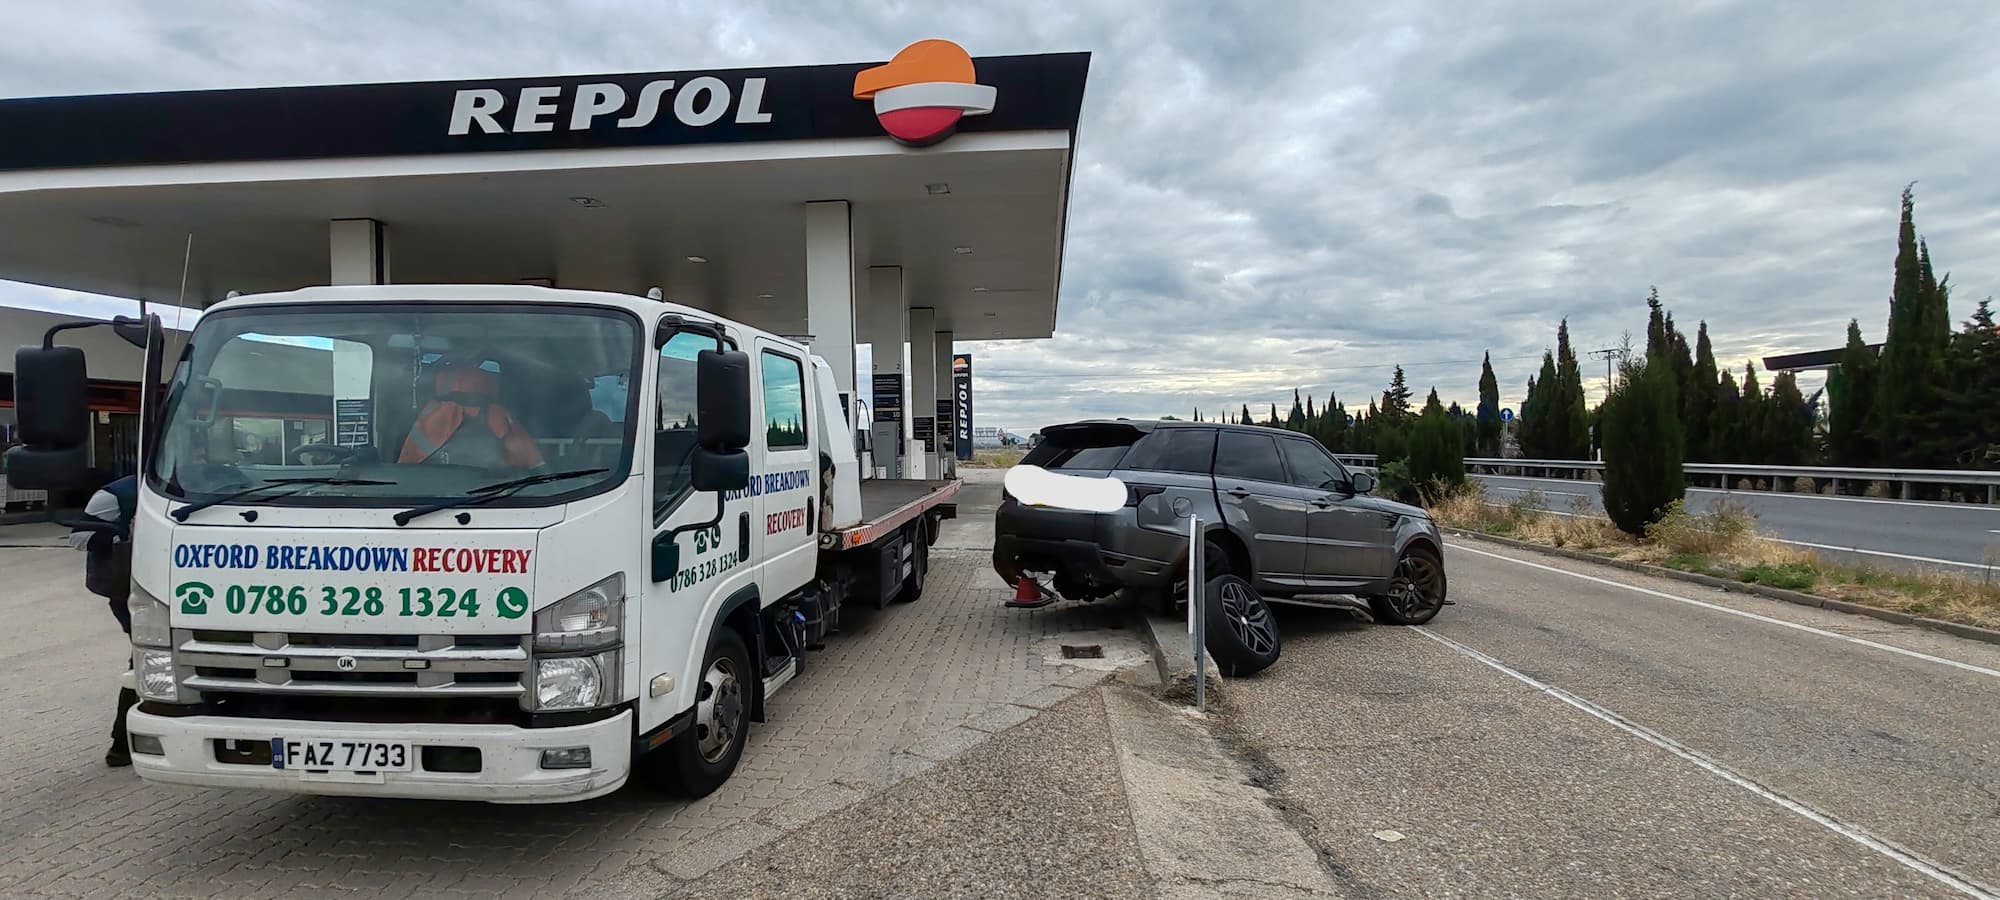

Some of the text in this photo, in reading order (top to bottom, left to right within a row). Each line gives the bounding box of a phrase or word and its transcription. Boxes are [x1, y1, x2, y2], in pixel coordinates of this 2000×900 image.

[448, 76, 773, 135] REPSOL
[959, 382, 968, 440] REPSOL
[764, 469, 810, 495] BREAKDOWN
[767, 507, 806, 536] RECOVERY
[174, 544, 532, 574] OXFORD BREAKDOWN RECOVERY
[670, 550, 738, 593] 0786 328 1324
[225, 585, 481, 618] 0786 328 1324
[340, 659, 353, 668] UK
[287, 742, 406, 767] FAZ 7733
